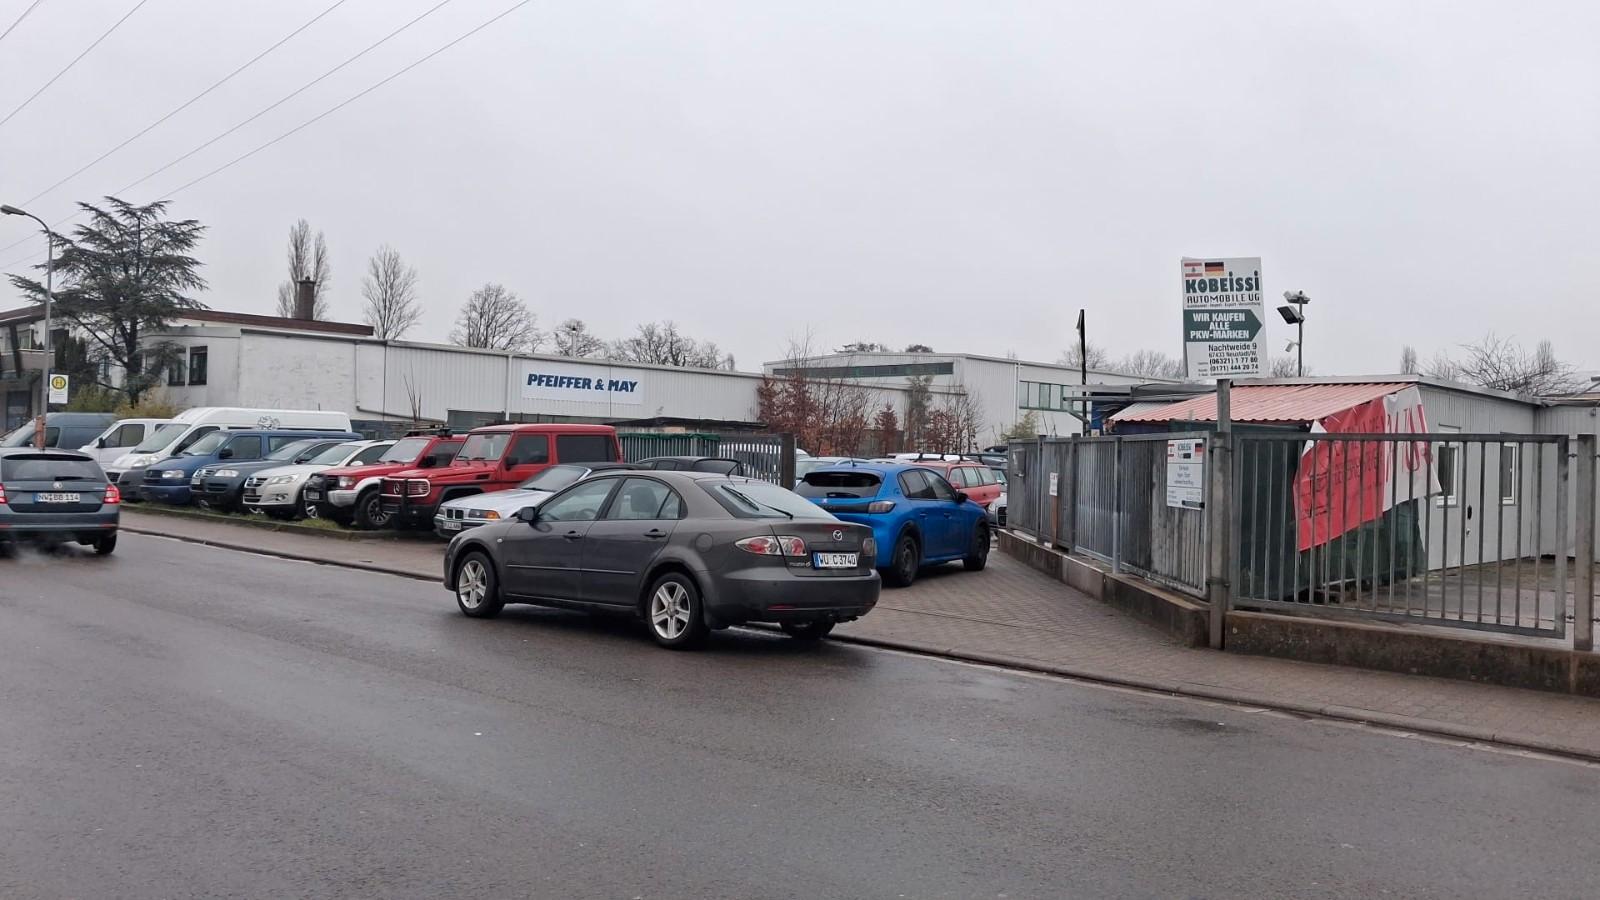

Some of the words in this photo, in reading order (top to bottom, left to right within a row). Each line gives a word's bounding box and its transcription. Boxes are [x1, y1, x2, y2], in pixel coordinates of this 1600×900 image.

[1187, 294, 1245, 303] AUTOMOBILE
[1248, 293, 1260, 301] UG
[1193, 313, 1210, 321] WIR
[1212, 313, 1245, 321] KAUFEN
[1209, 322, 1230, 330] ALLE
[1190, 330, 1249, 338] PKW-MARKEN
[527, 374, 592, 390] PFEIFFER
[594, 378, 604, 390] &
[608, 380, 638, 392] MAY
